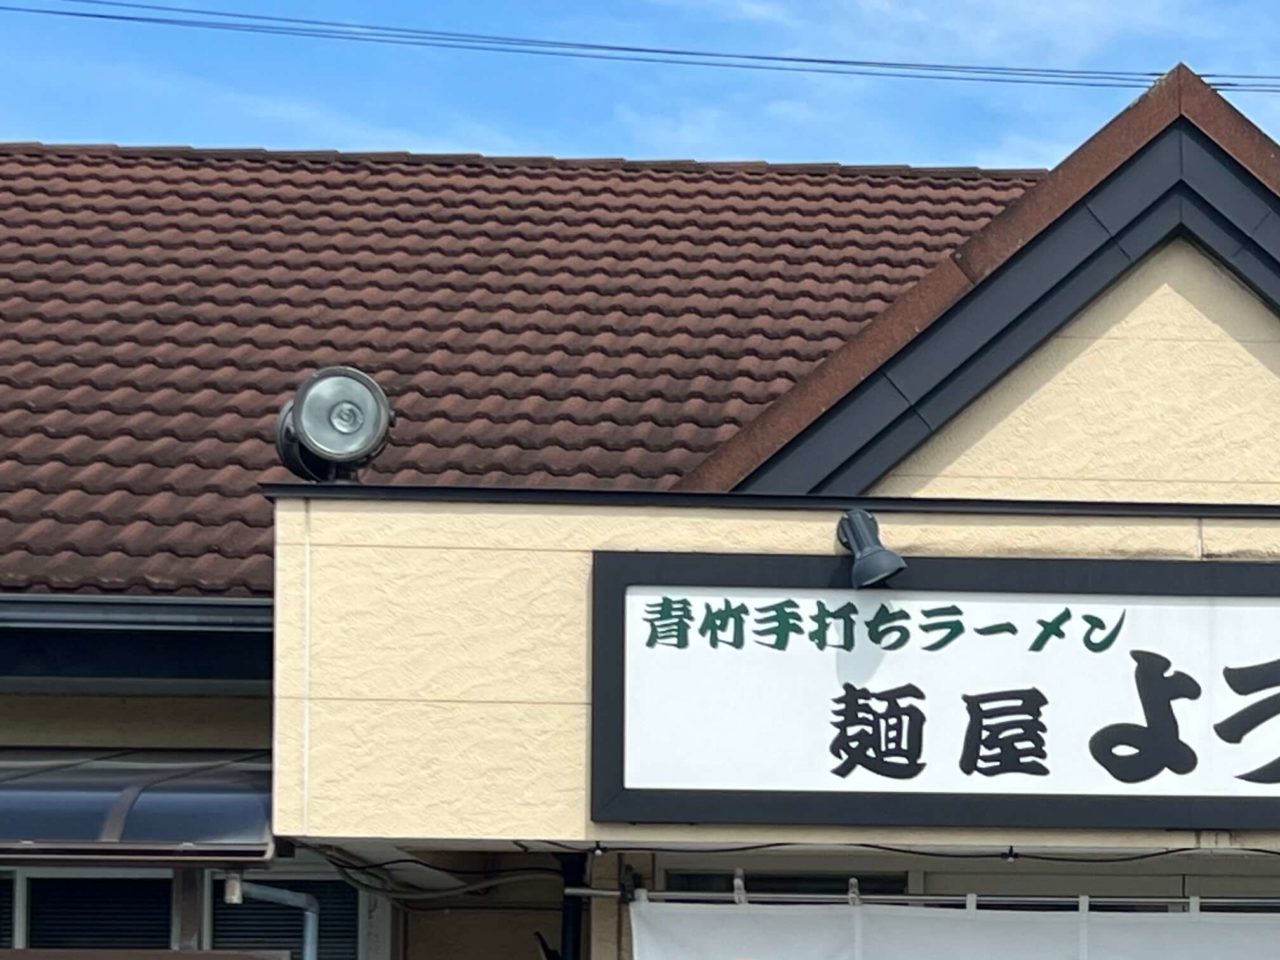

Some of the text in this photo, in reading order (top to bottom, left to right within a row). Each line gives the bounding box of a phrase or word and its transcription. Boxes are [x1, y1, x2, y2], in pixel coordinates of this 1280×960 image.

[643, 597, 1127, 652] 青竹手打ちラーメン
